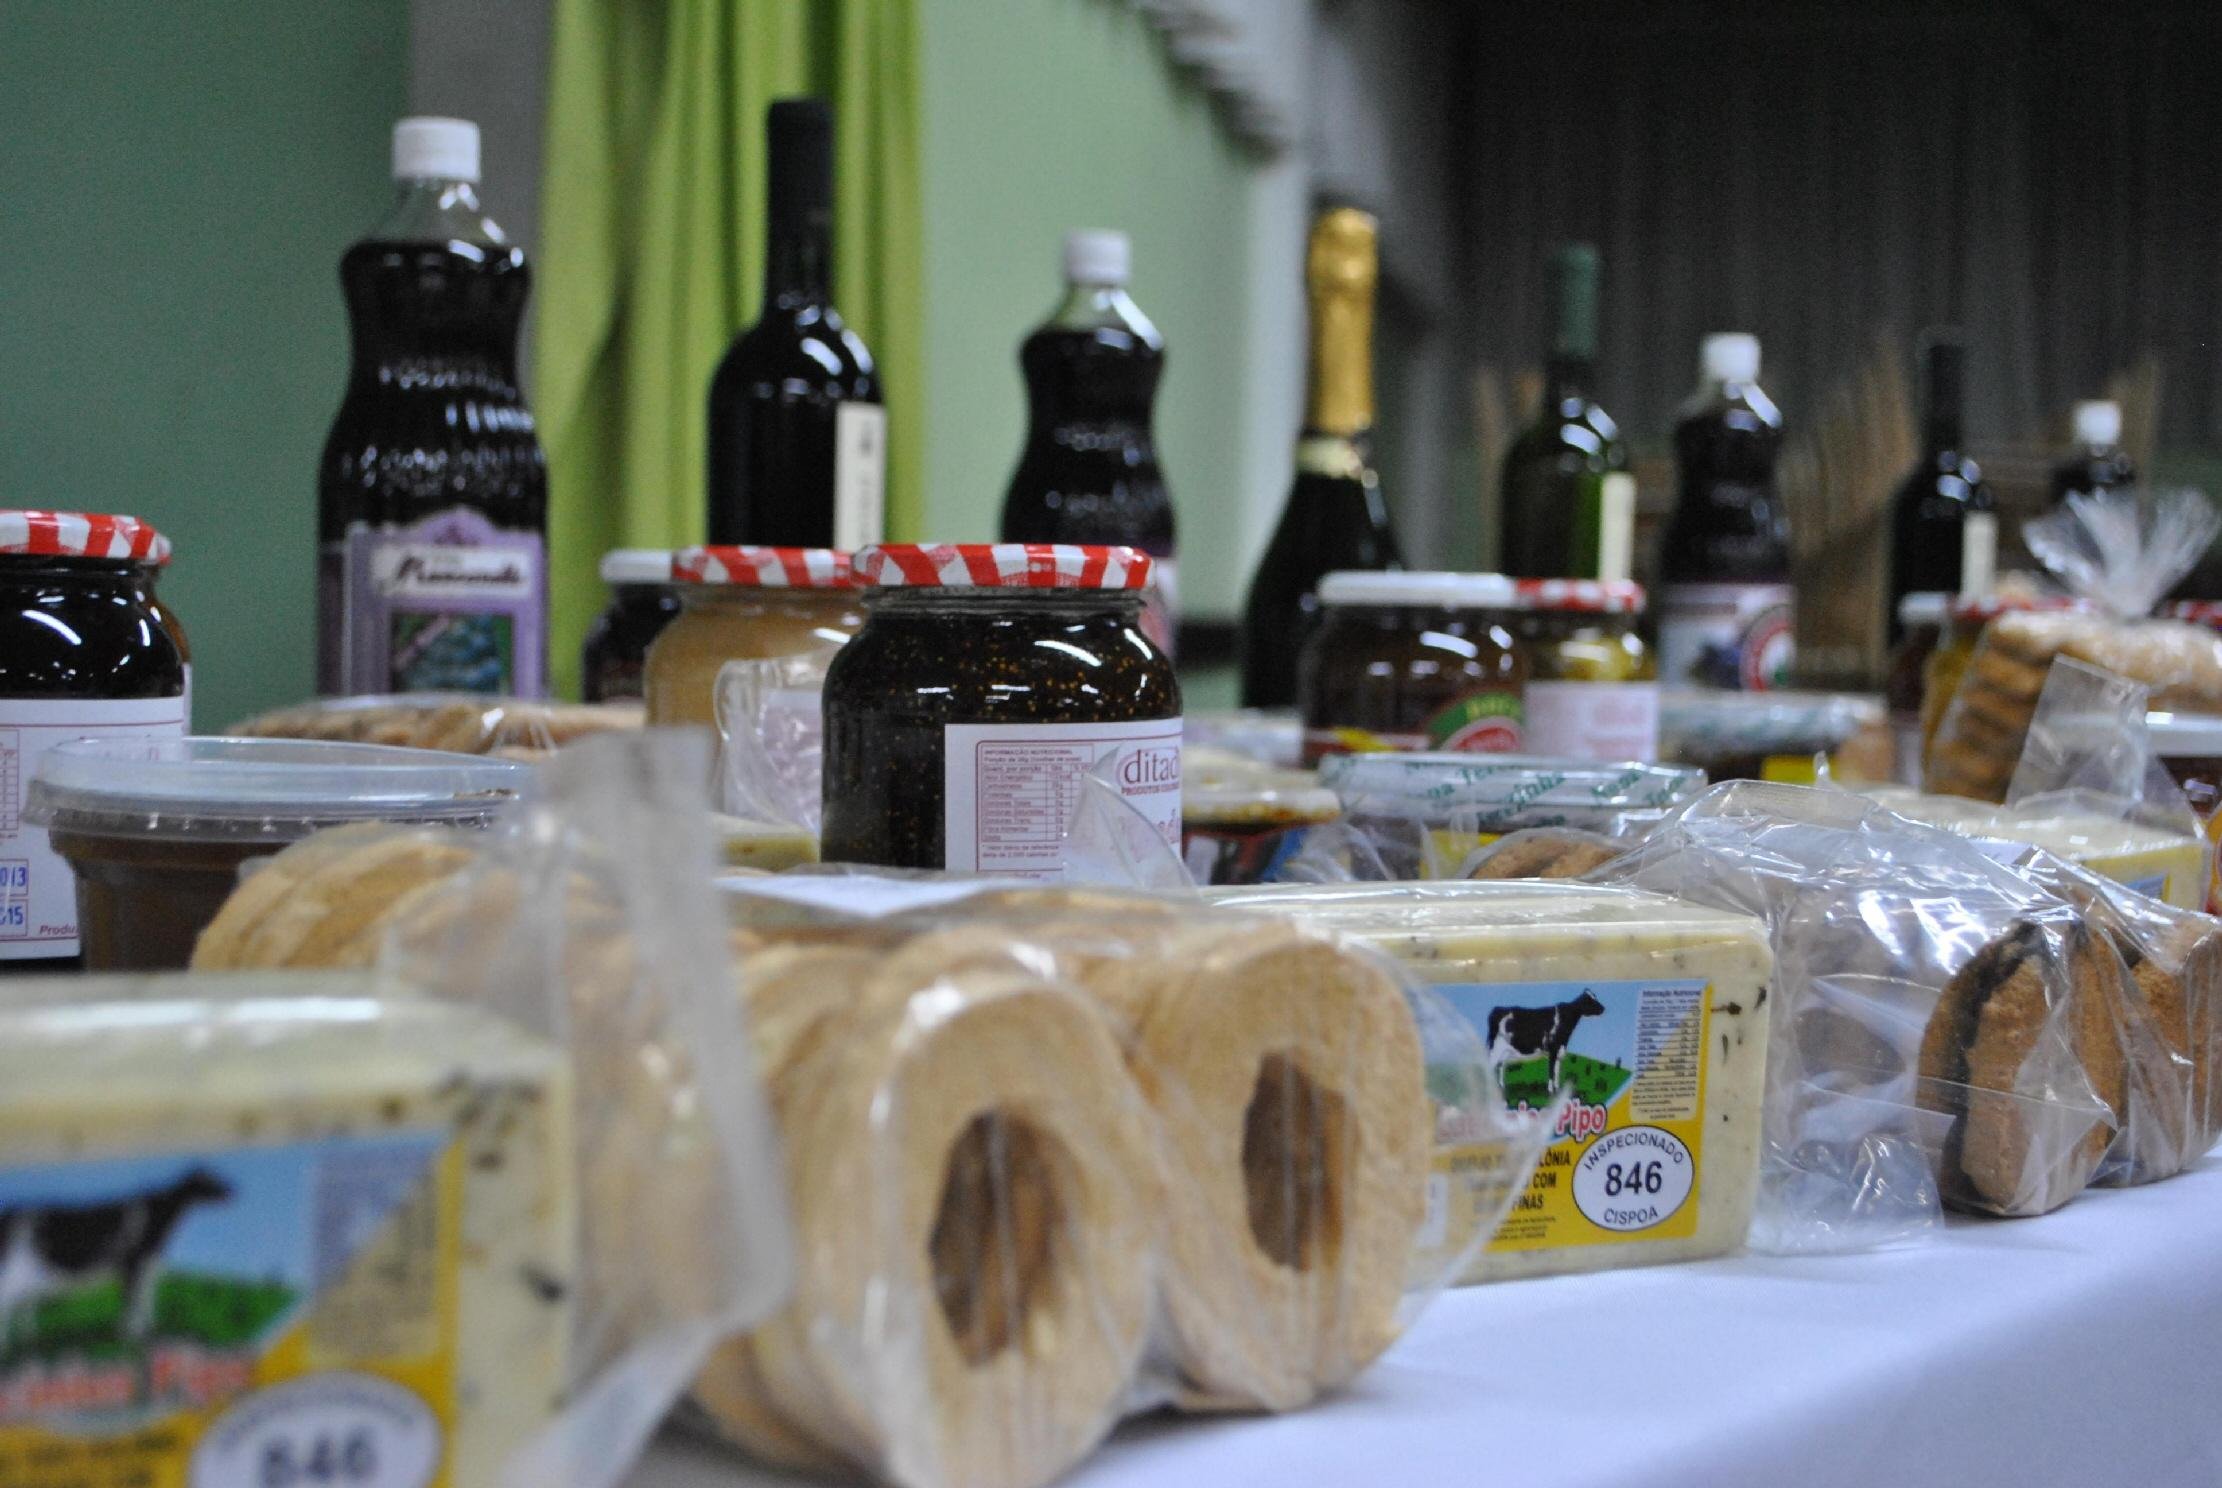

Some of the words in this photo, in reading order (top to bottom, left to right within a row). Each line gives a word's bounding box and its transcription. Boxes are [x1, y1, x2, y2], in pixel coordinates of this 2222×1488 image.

[1584, 1132, 1685, 1171] INSPECIONADO
[1532, 1172, 1557, 1190] COM
[1605, 1160, 1663, 1197] 846
[1603, 1206, 1660, 1225] CISPOA
